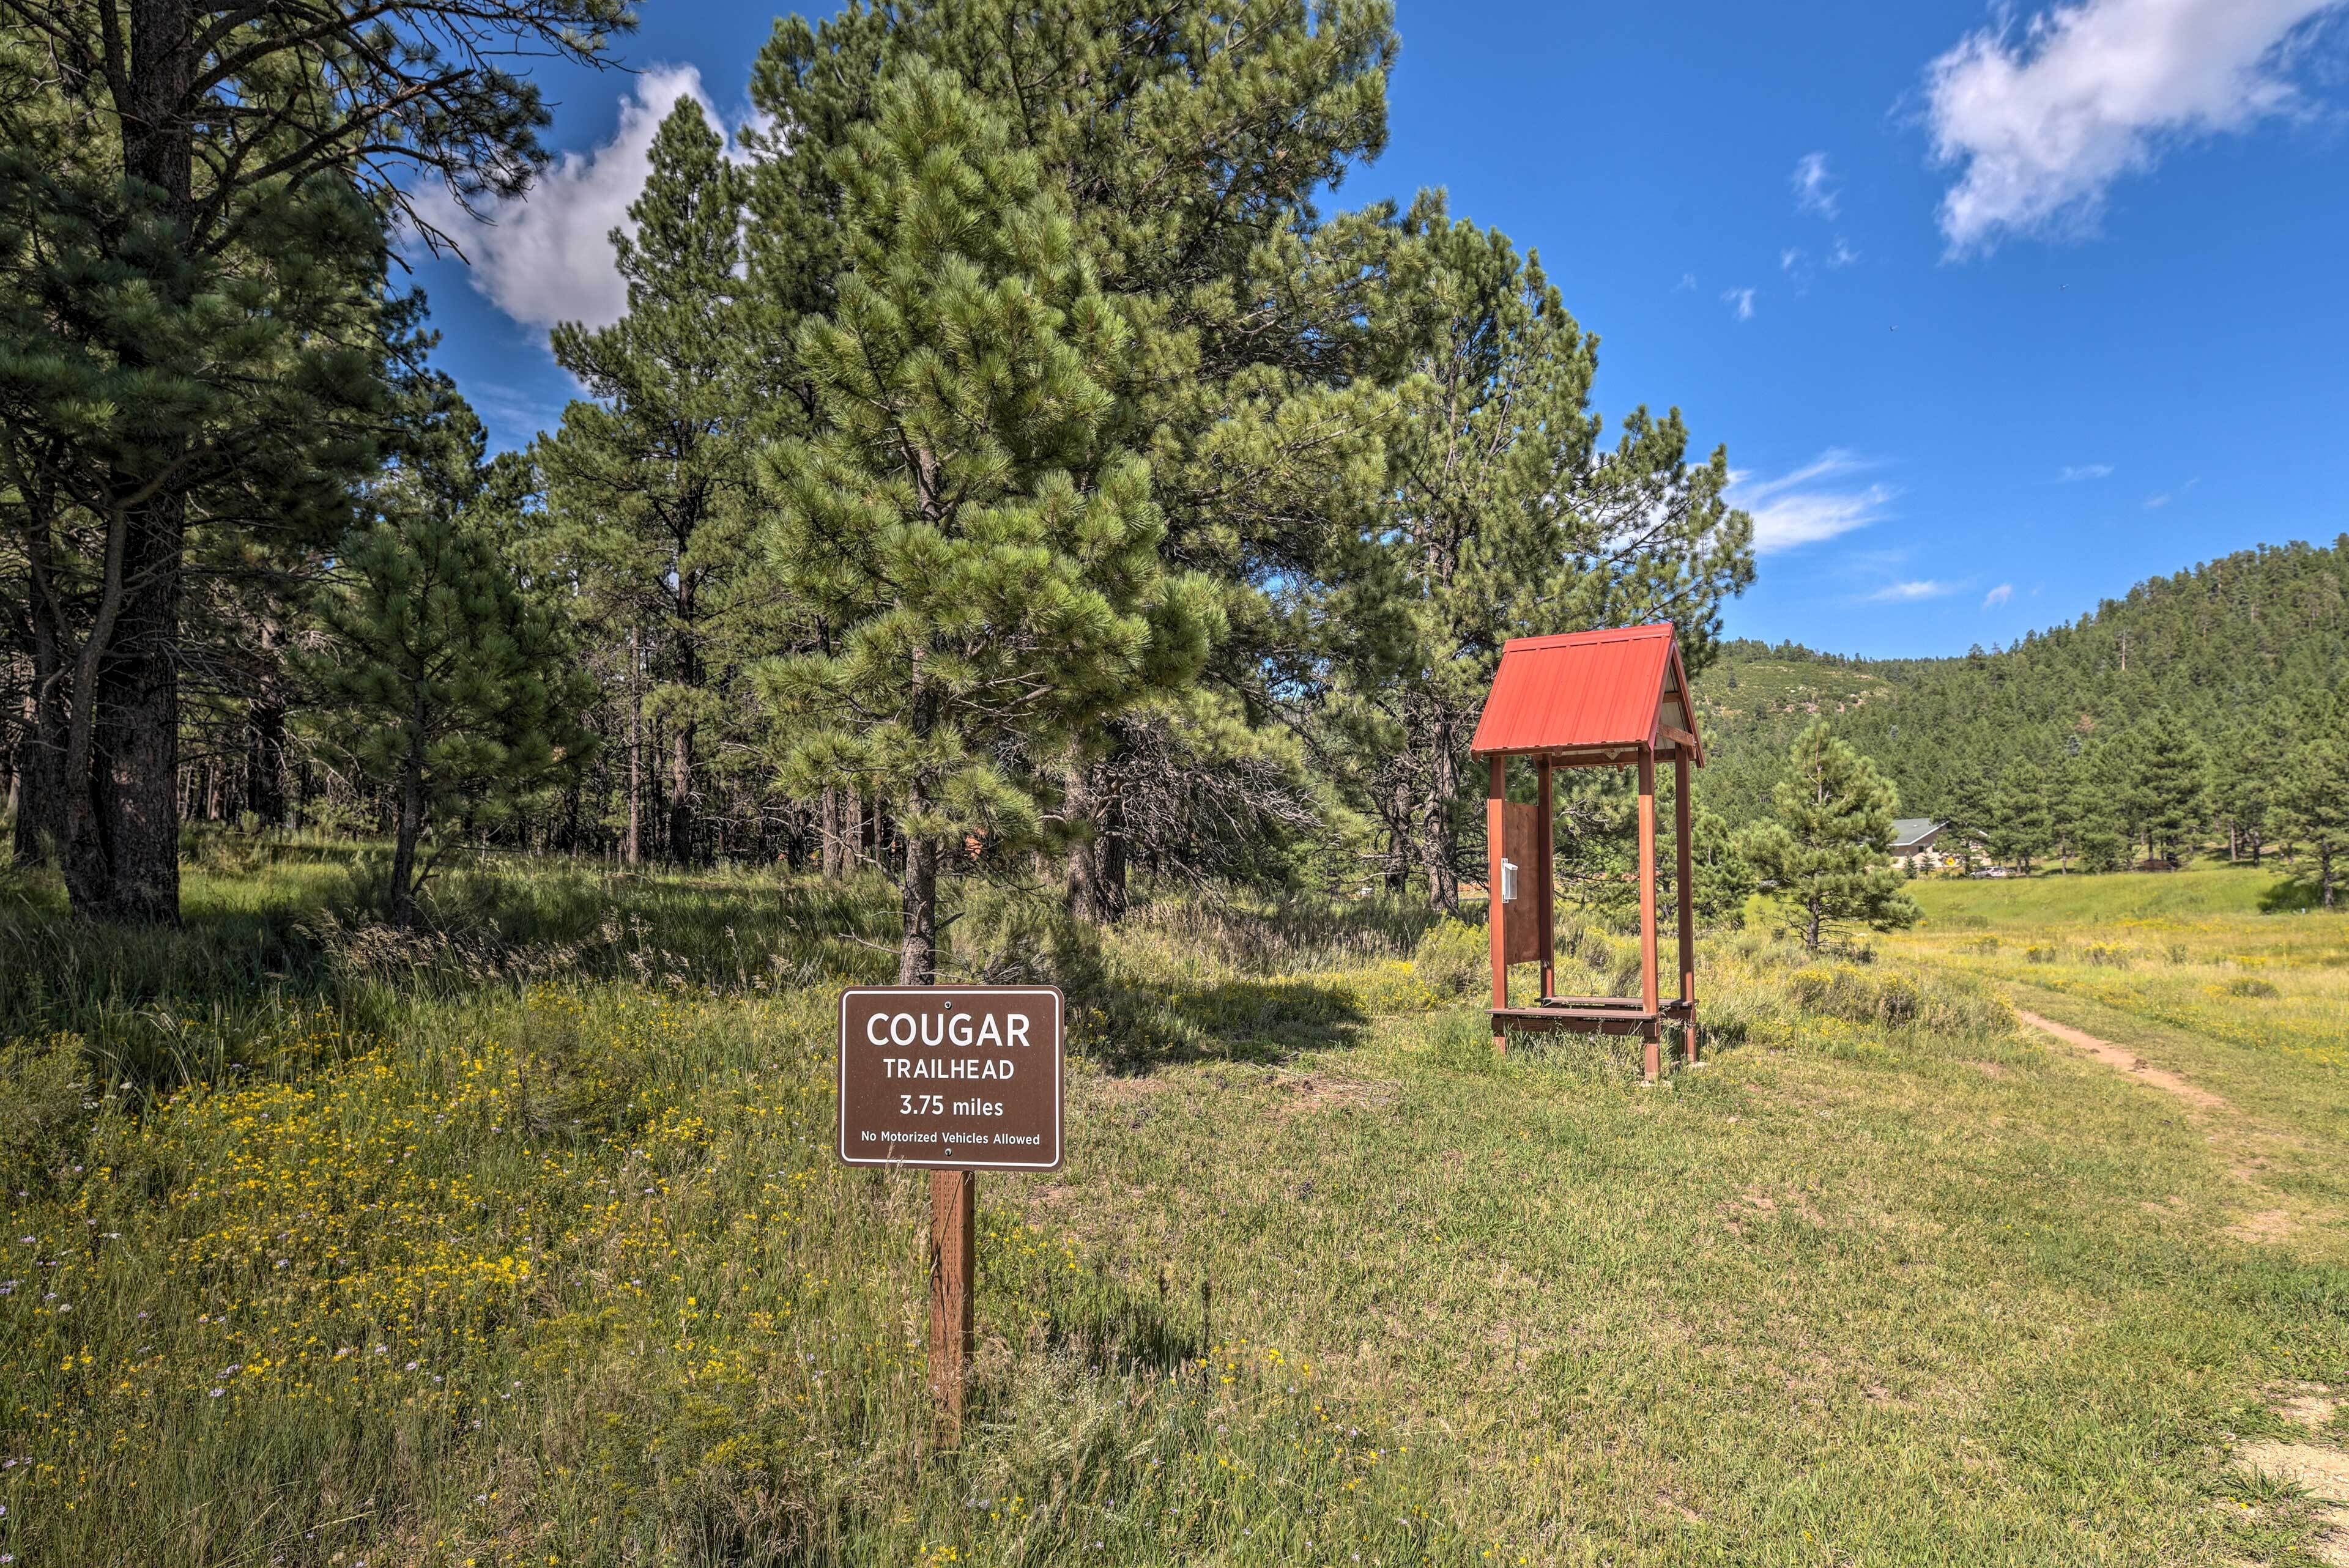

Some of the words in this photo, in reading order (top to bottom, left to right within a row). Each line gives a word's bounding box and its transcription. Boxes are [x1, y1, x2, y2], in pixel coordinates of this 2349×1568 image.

[867, 1013, 1030, 1046] COUGAR
[883, 1059, 1014, 1079] TRAILHEAD
[900, 1095, 943, 1114] 3.75
[954, 1098, 1003, 1115] miles
[862, 1131, 876, 1141] No
[881, 1131, 937, 1142] Motorized
[942, 1133, 988, 1143] Vehicles
[993, 1134, 1039, 1145] Allowed
